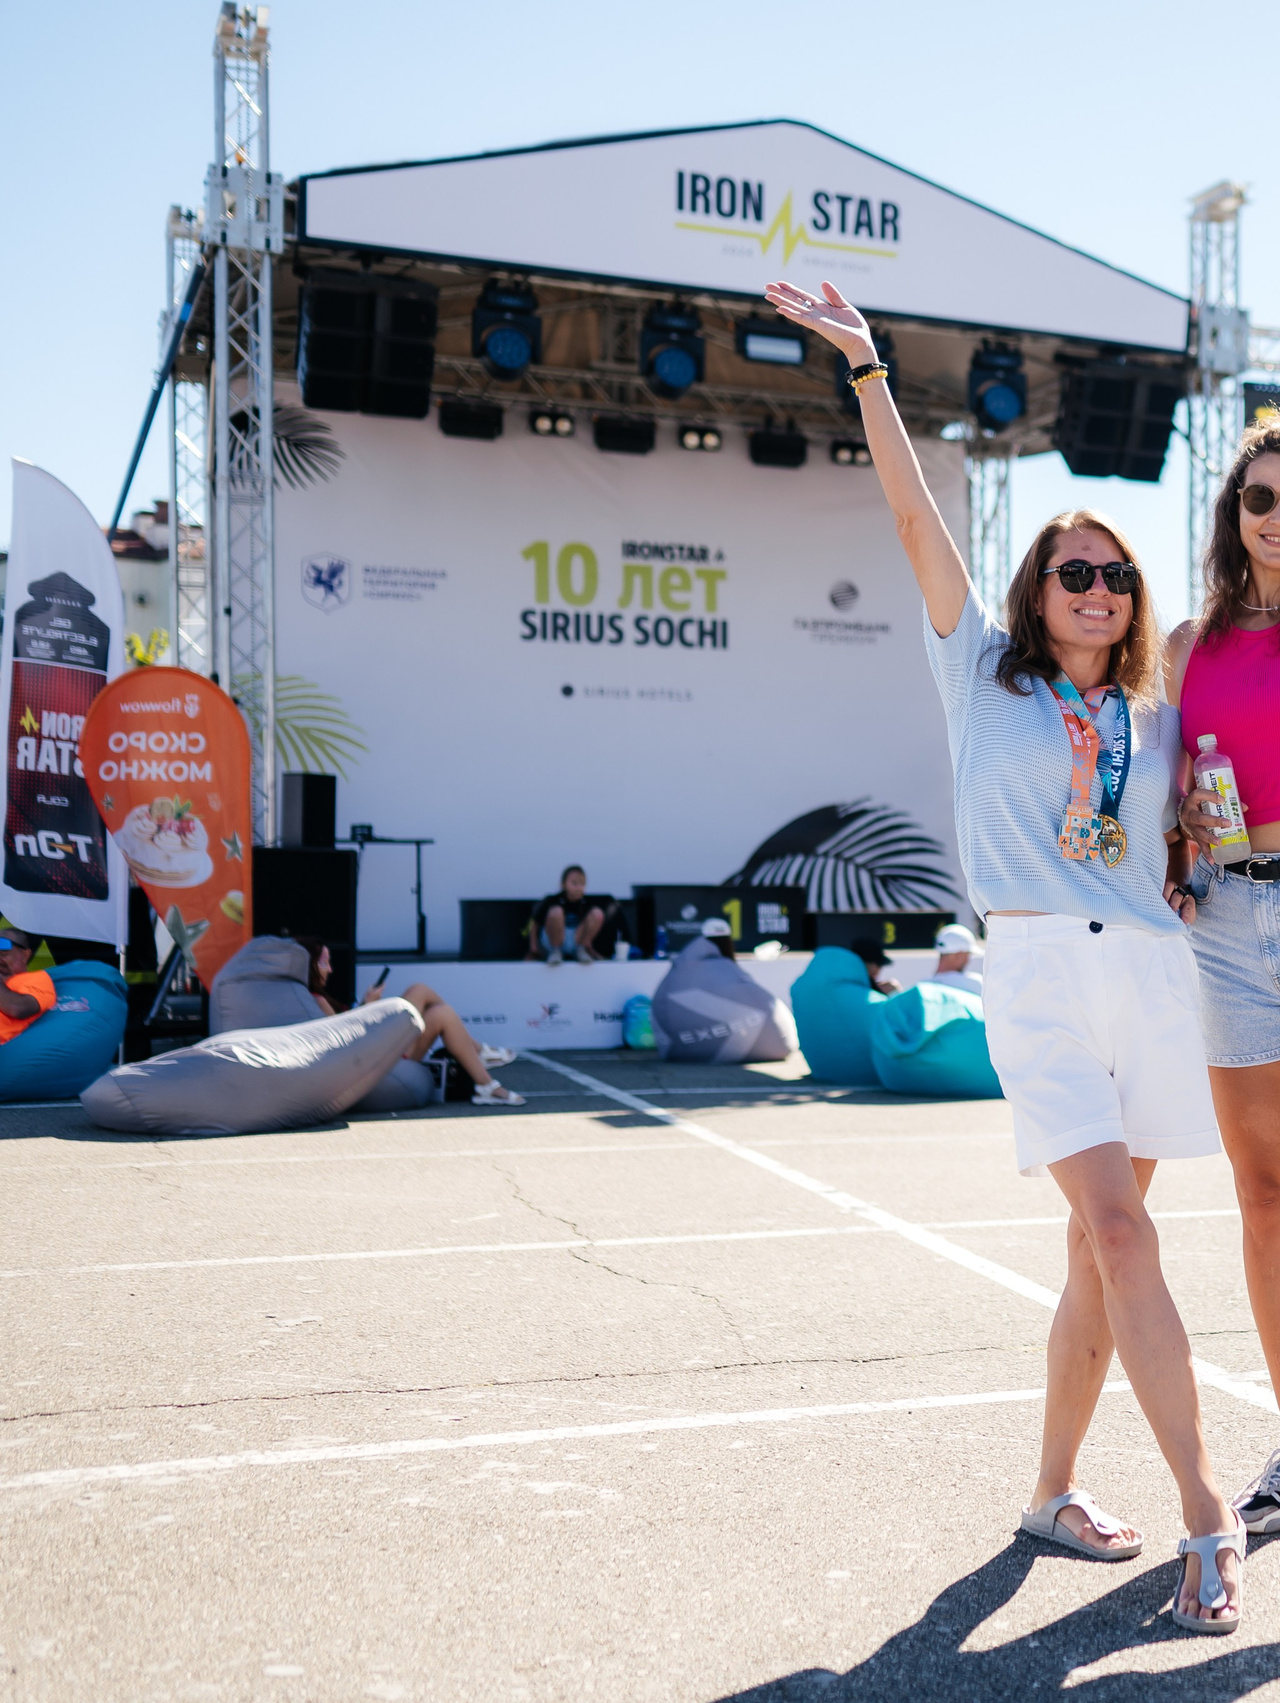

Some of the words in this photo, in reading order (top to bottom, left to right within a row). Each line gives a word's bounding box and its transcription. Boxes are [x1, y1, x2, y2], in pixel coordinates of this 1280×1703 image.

[676, 170, 763, 222] IRON
[811, 191, 900, 242] STAR
[620, 541, 709, 562] IRONSTAR
[521, 541, 599, 607] 10
[617, 564, 727, 613] лет
[520, 610, 625, 645] SIRIUS
[633, 615, 729, 650] SOCHI
[1112, 739, 1126, 767] SOCHI
[1108, 846, 1119, 854] 10
[722, 899, 741, 941] 1
[678, 1013, 763, 1045] EXEED
